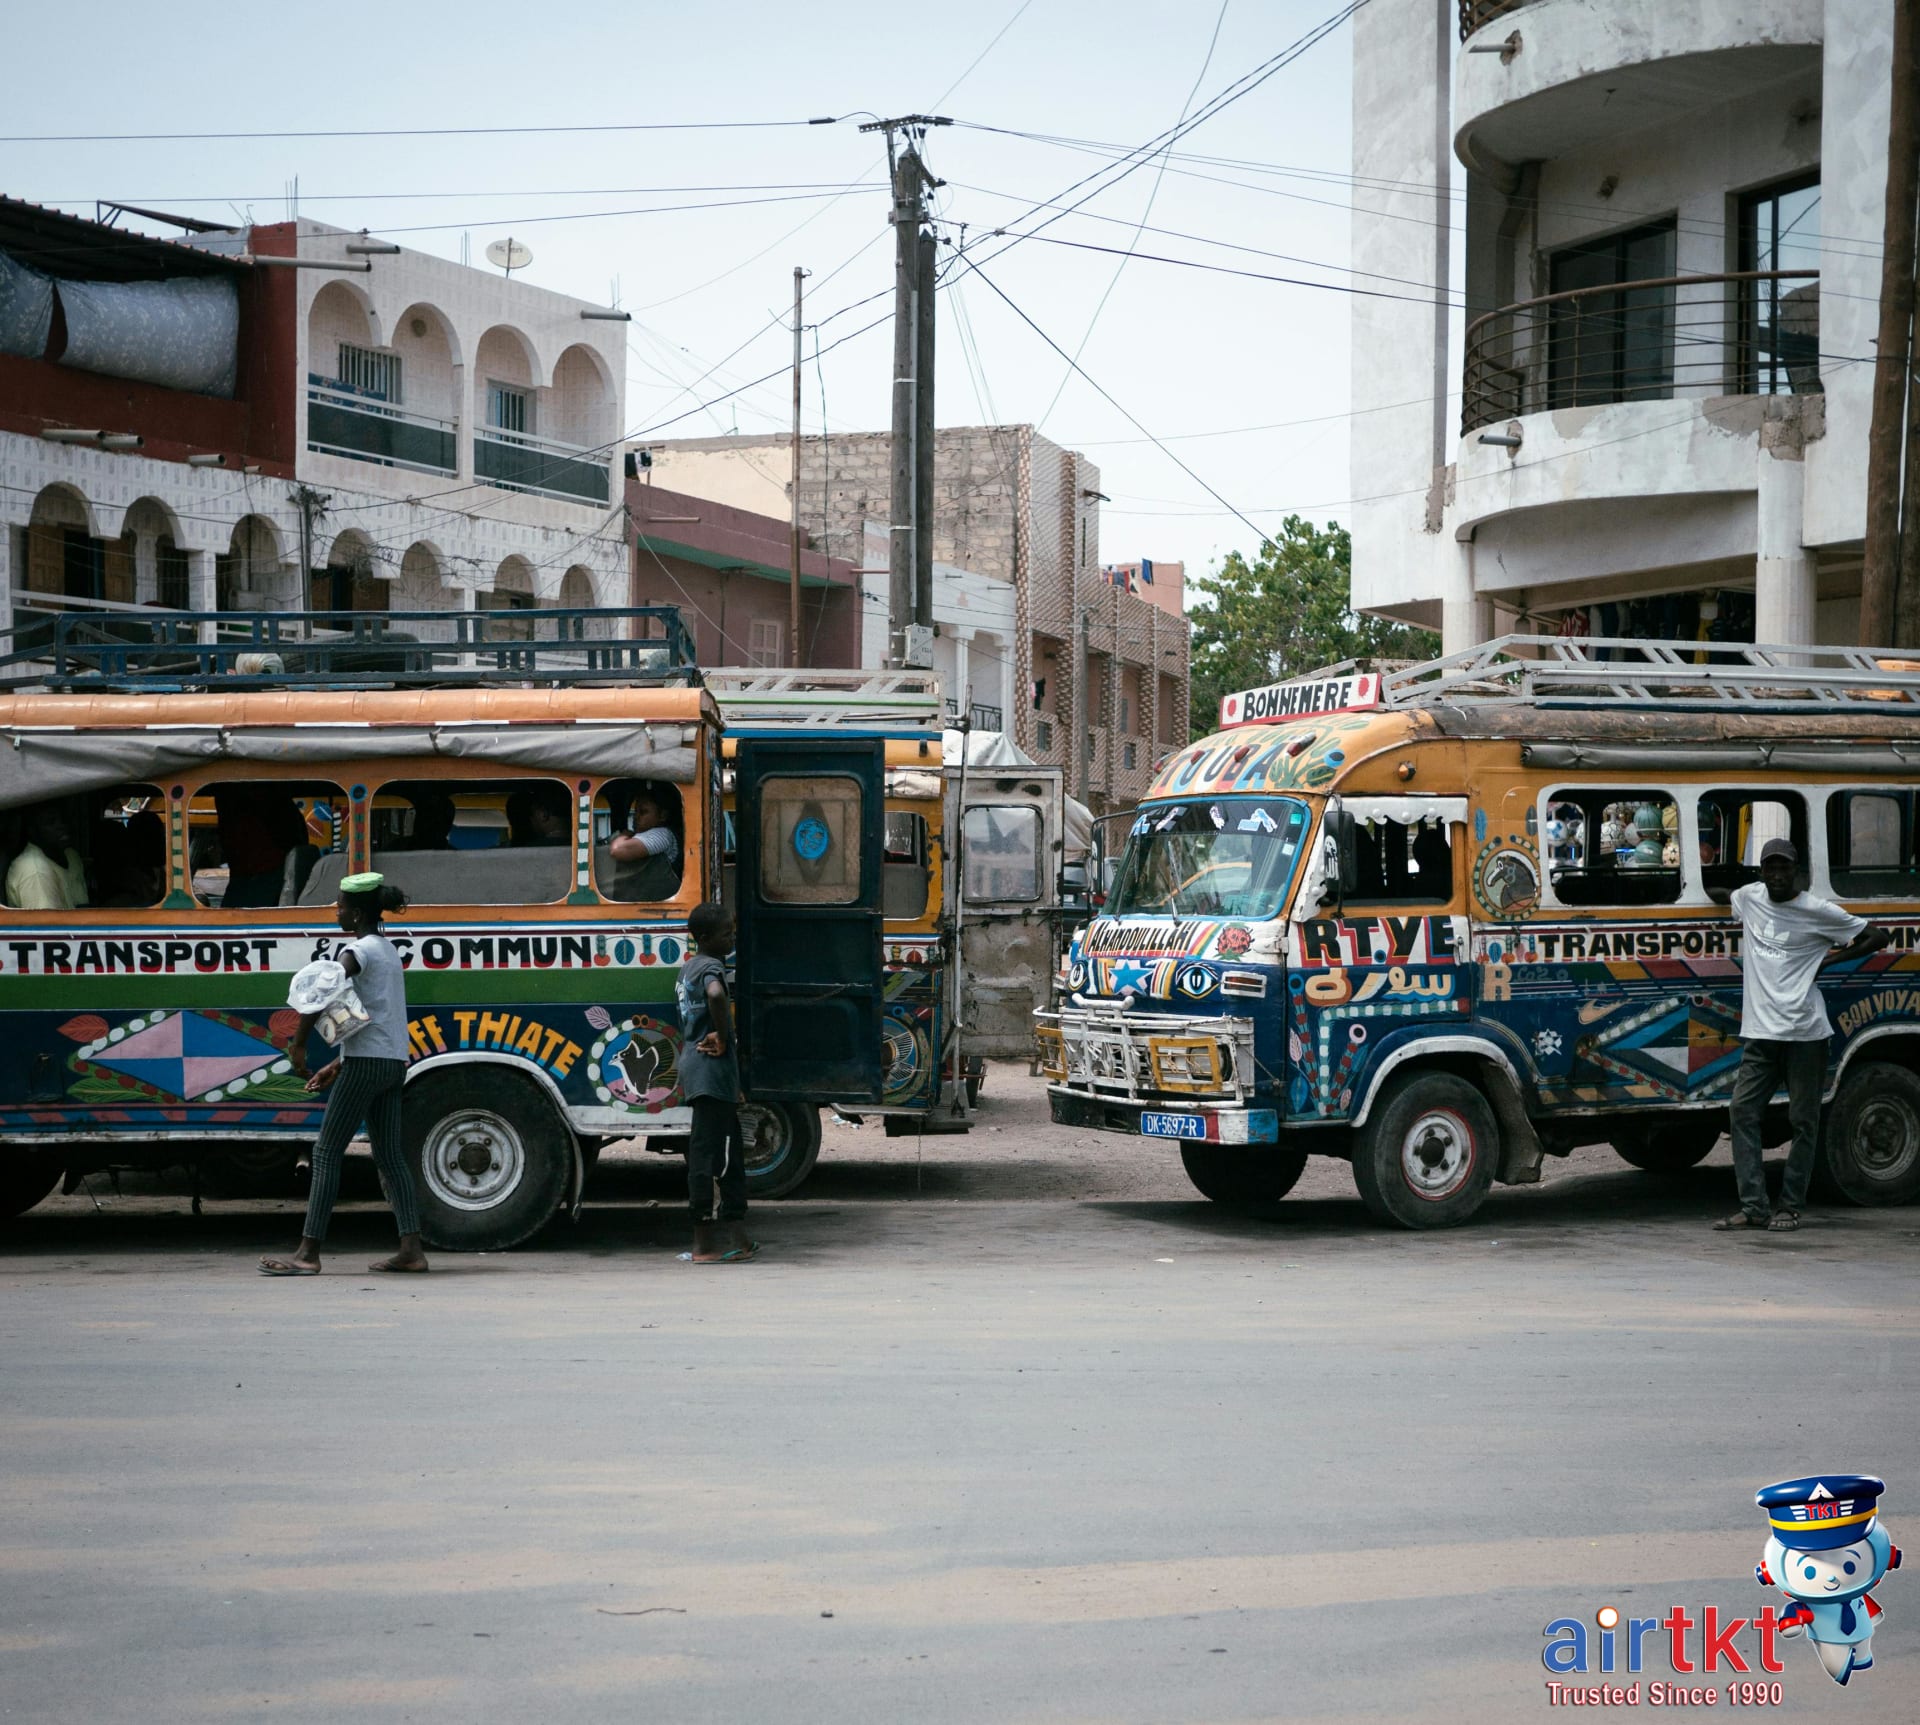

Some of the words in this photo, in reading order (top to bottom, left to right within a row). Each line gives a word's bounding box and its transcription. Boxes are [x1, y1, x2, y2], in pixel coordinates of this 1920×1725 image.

[1243, 681, 1352, 722] BONNEMERE
[1155, 742, 1288, 796] TOUBA
[9, 939, 278, 974] TRANSPORT
[1538, 930, 1743, 962] TRANSPORT
[453, 1011, 583, 1080] THIATE
